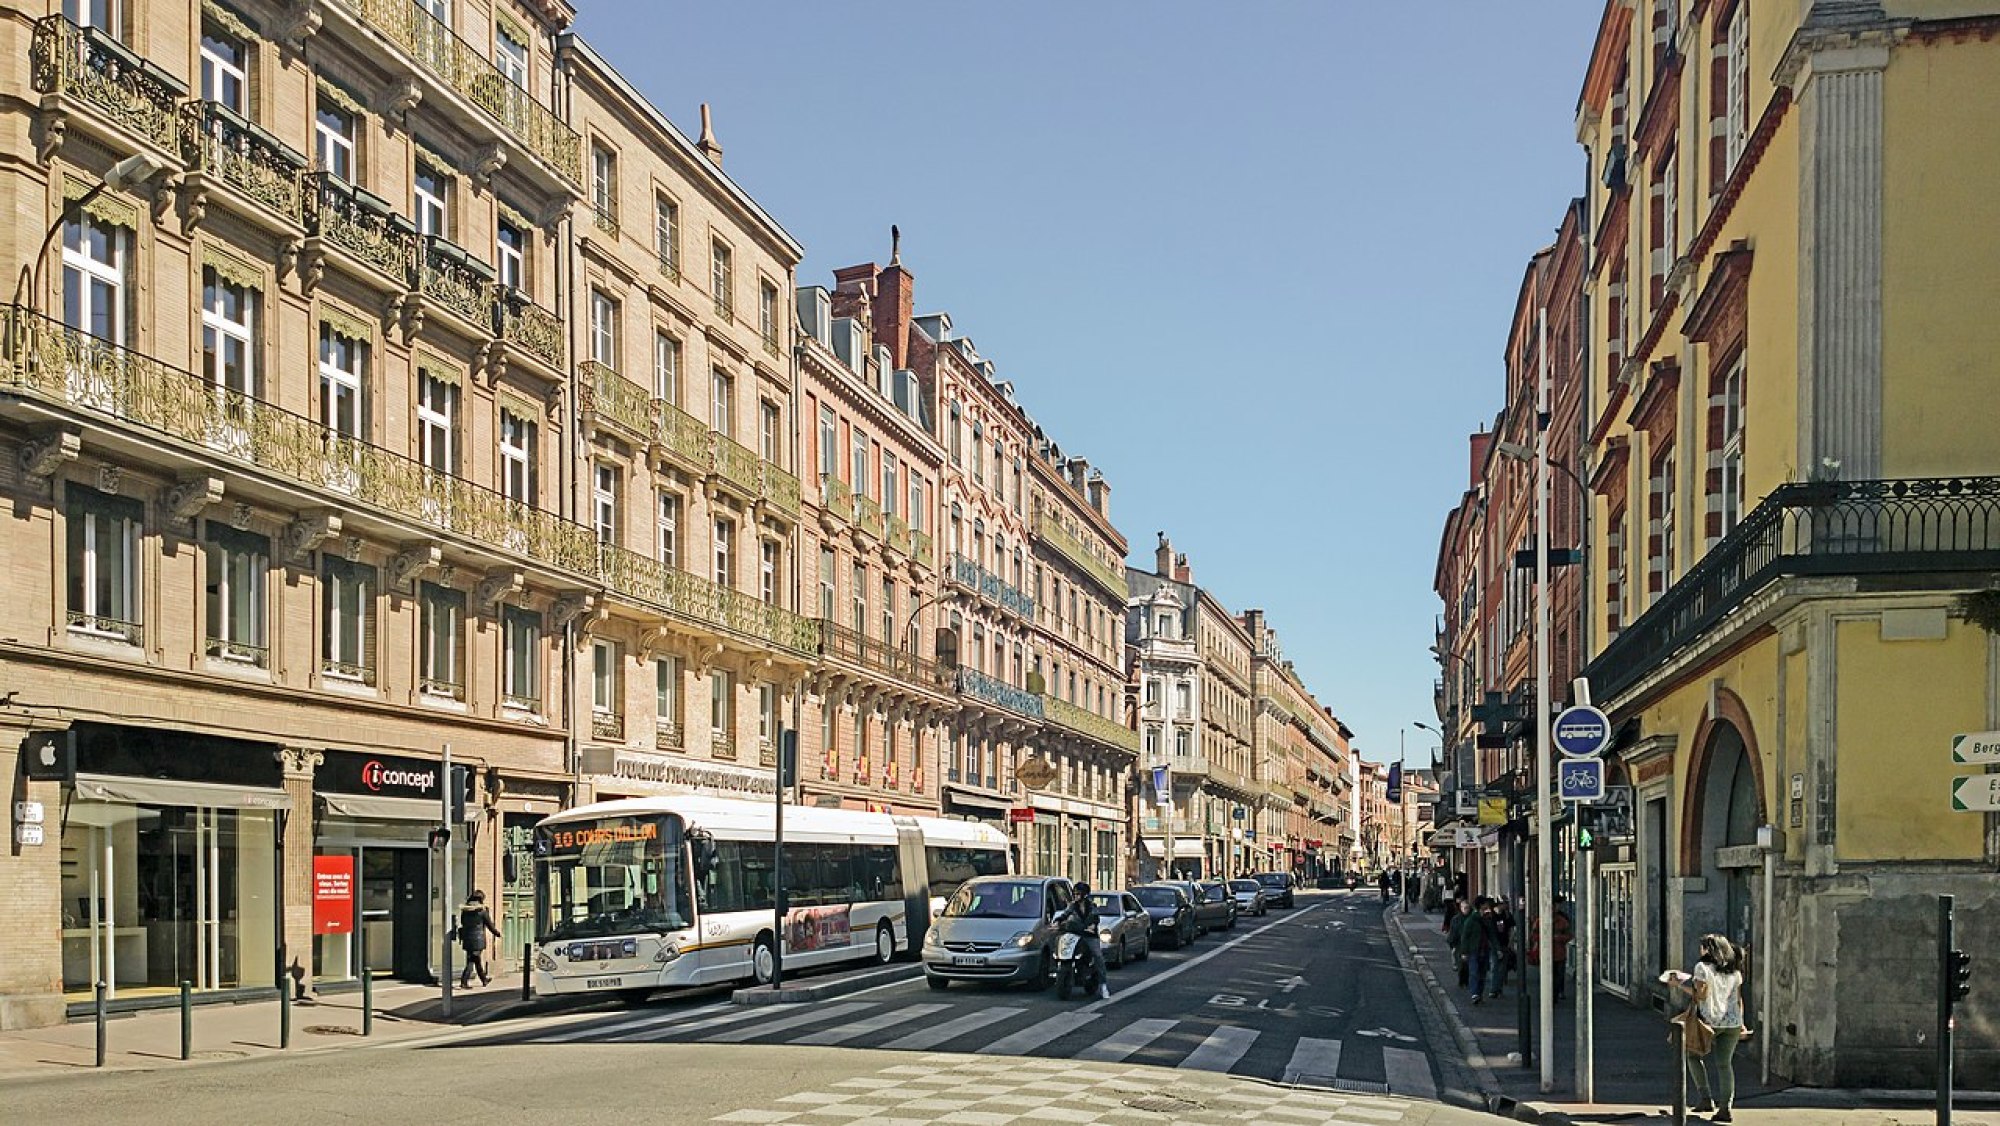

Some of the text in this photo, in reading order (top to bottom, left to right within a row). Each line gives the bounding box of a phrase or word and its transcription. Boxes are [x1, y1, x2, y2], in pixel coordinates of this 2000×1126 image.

[553, 832, 573, 849] 10
[575, 828, 613, 846] COURS
[1208, 994, 1344, 1018] BUS
